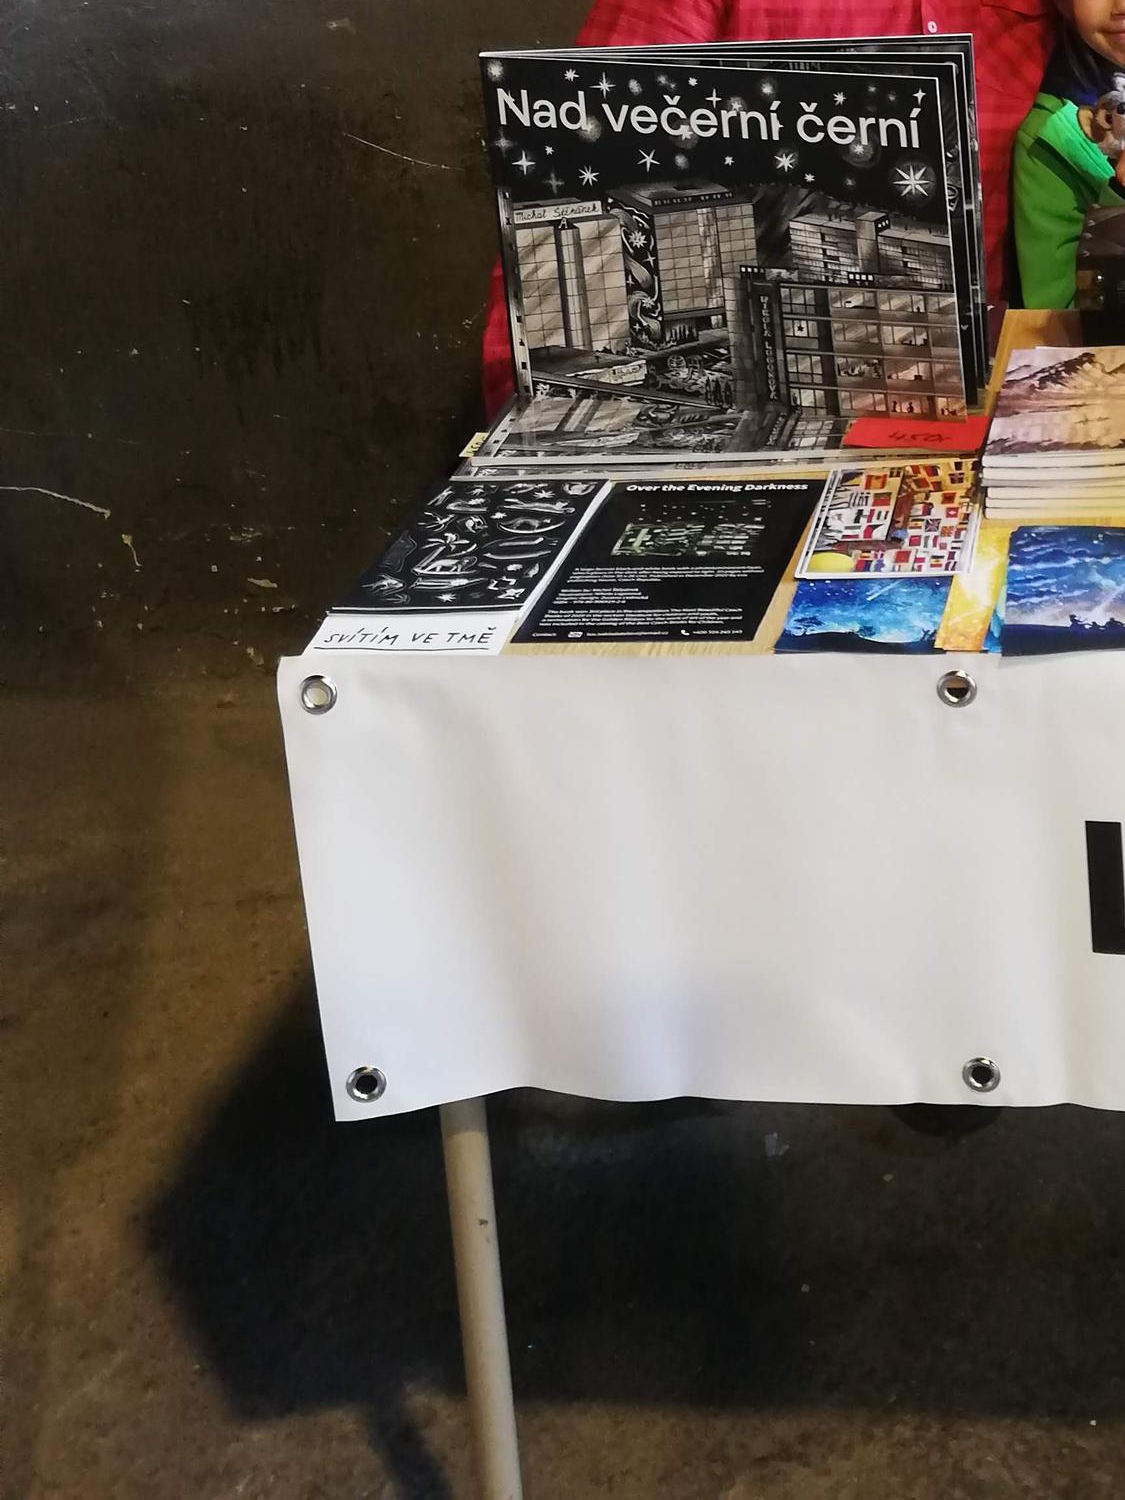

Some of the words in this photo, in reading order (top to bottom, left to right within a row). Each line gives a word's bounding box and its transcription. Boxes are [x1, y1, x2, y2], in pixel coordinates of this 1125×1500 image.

[496, 88, 586, 131] Nad
[601, 94, 782, 141] večerní
[796, 101, 921, 149] černí
[626, 484, 660, 492] Over
[661, 484, 685, 492] the
[687, 483, 743, 493] Evening
[744, 483, 809, 492] Darkness
[324, 626, 400, 646] SVÍTÍM
[411, 632, 439, 644] VE
[447, 626, 497, 645] TMĚ
